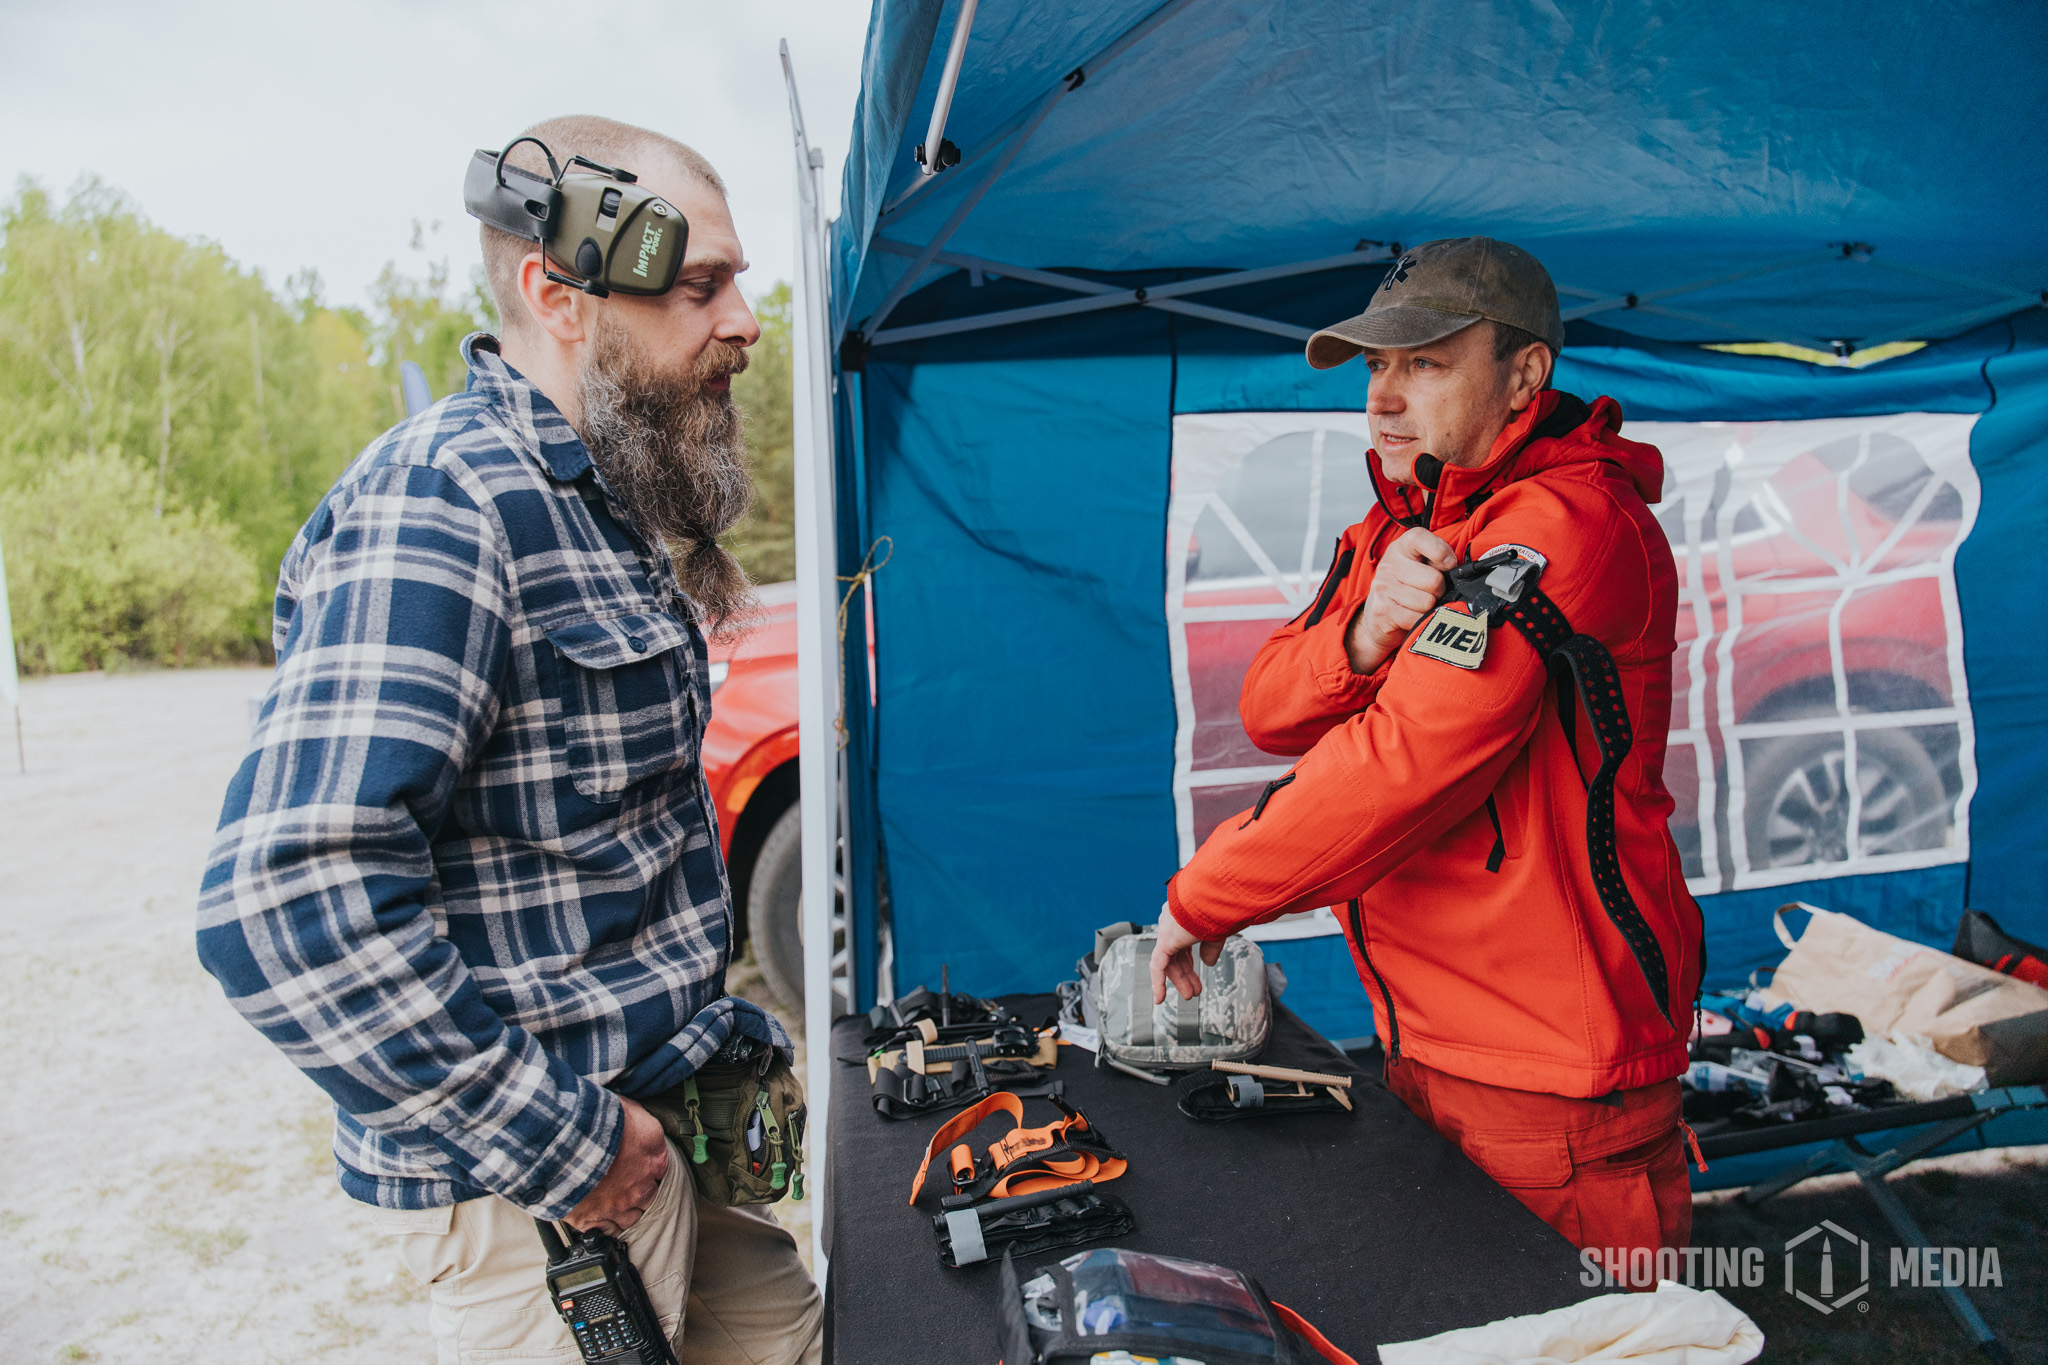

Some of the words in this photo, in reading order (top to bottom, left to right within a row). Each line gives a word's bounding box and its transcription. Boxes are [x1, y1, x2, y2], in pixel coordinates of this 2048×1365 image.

[633, 225, 655, 278] IMPACT
[650, 231, 662, 256] SPORT
[1426, 621, 1485, 654] MED
